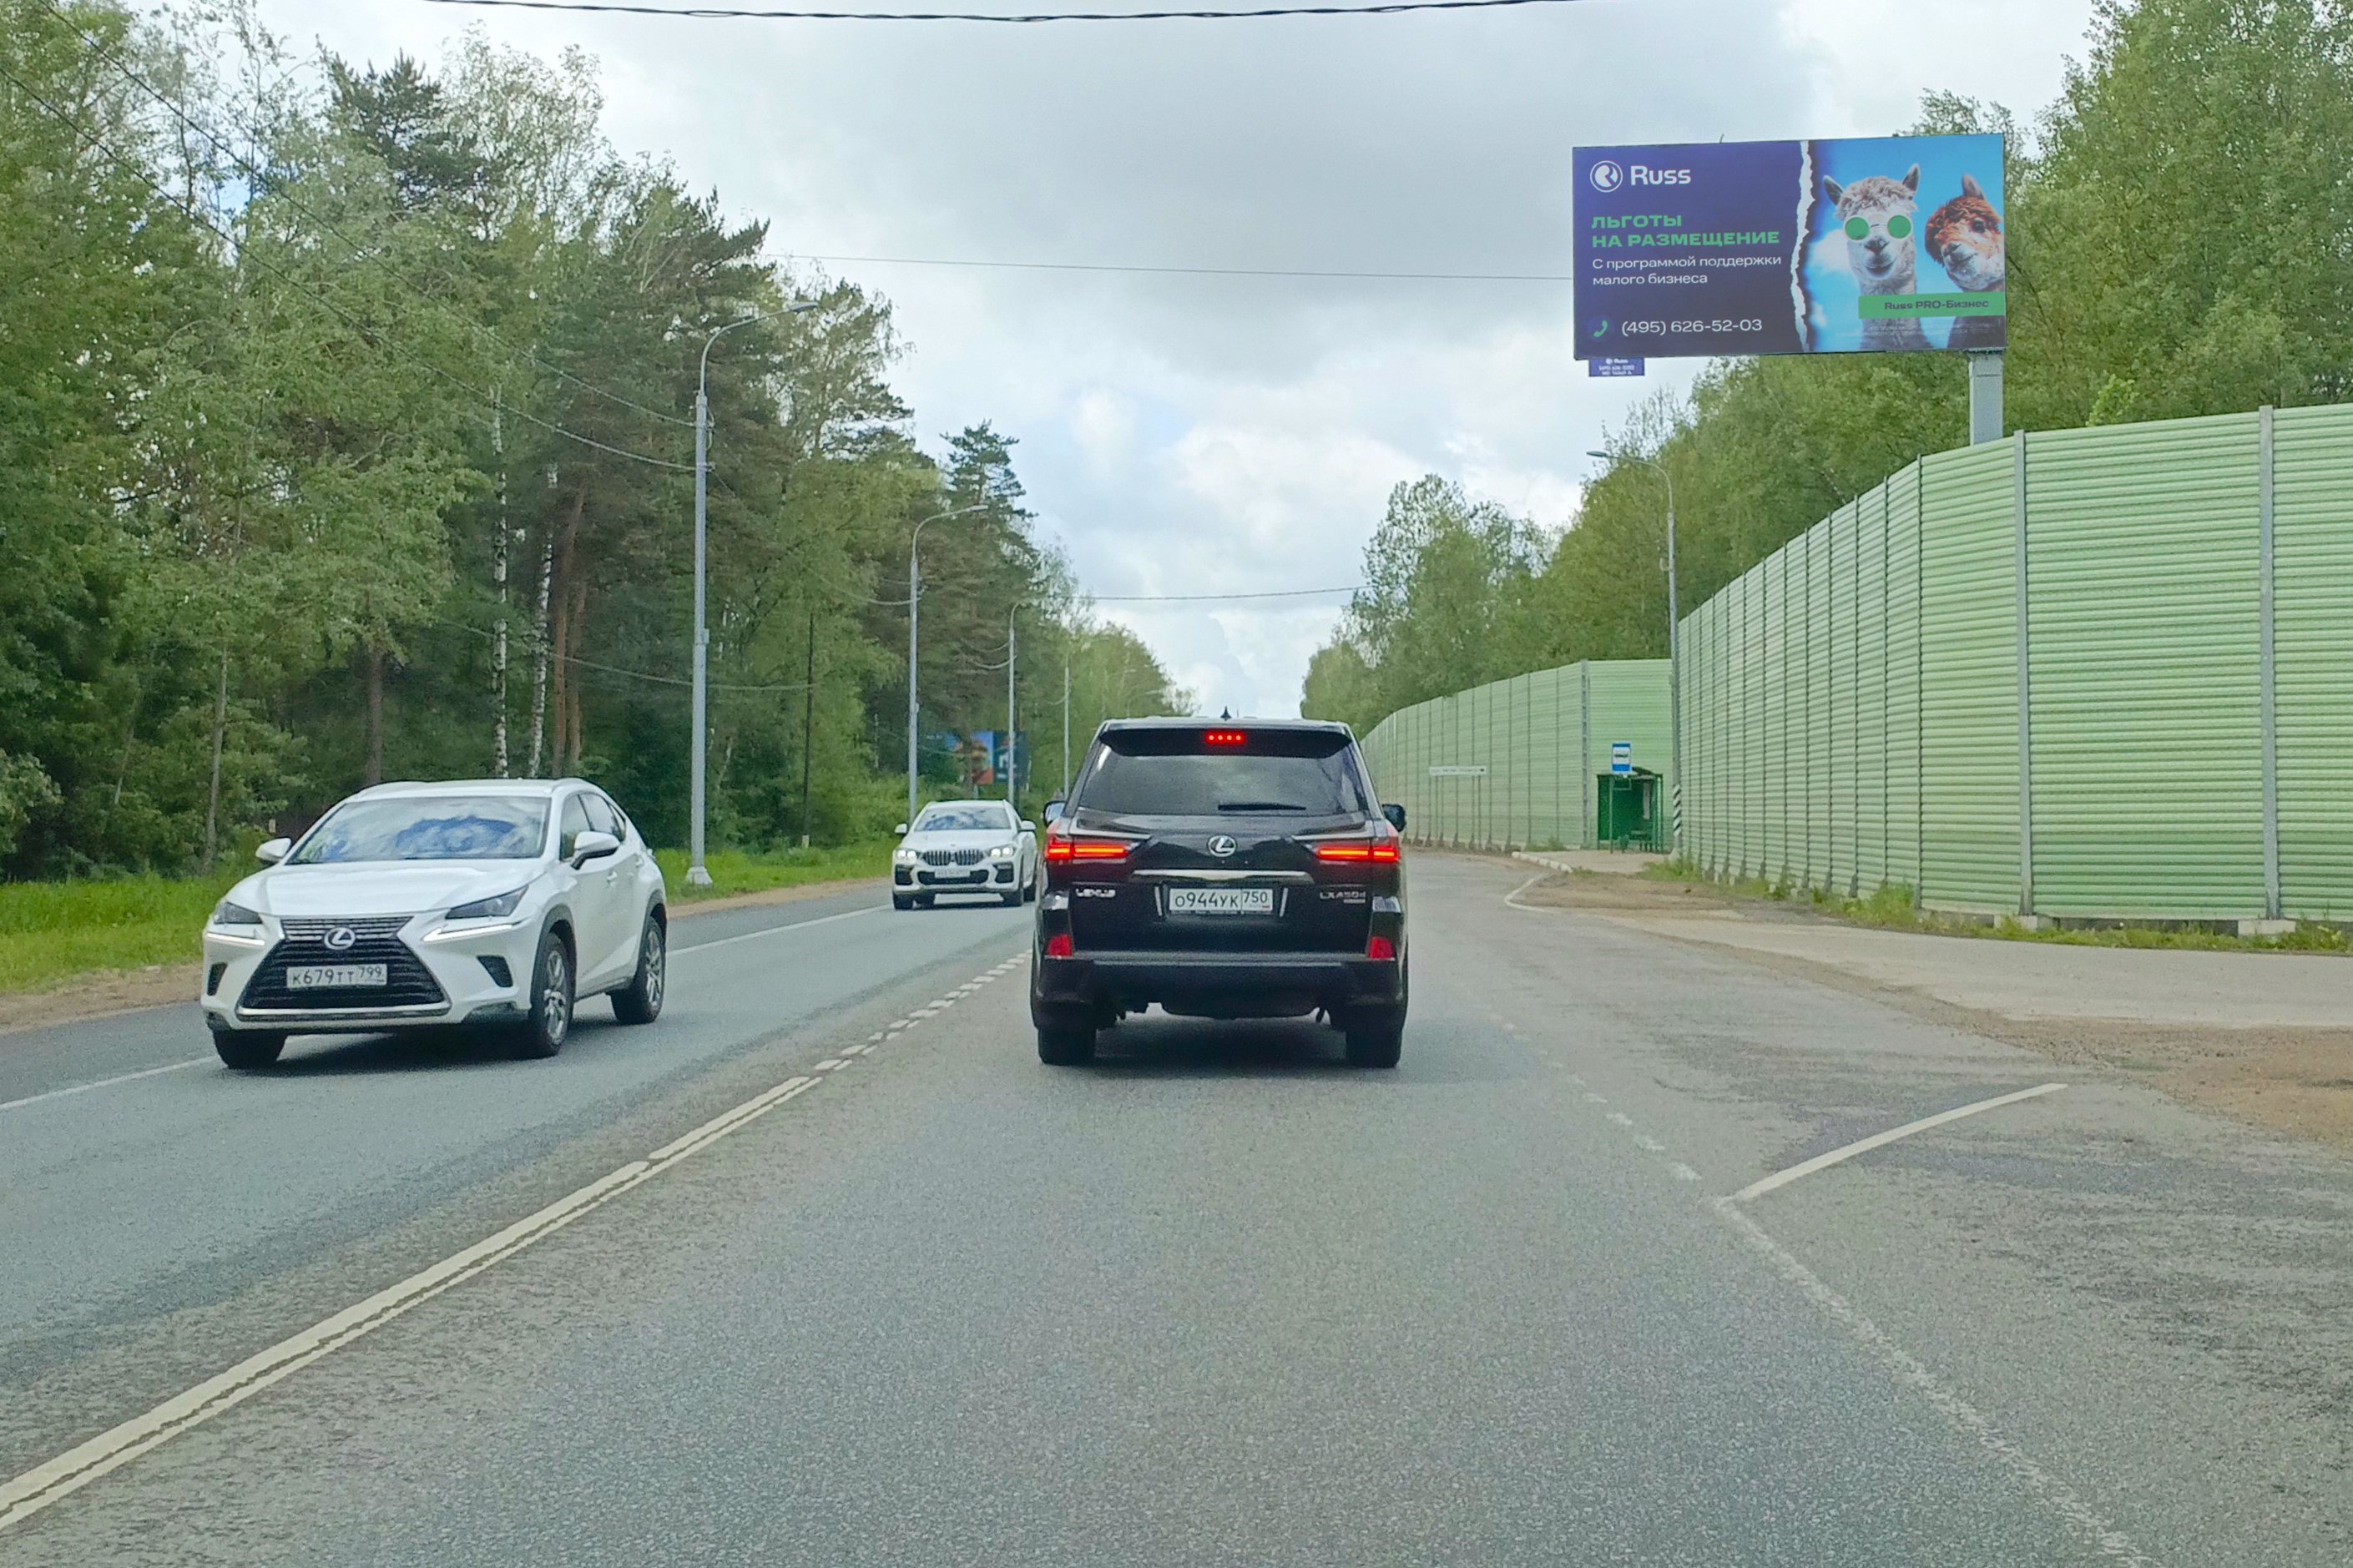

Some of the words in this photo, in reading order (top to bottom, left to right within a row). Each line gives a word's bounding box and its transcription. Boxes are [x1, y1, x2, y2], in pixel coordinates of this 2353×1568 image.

[1630, 165, 1691, 186] Russ
[1592, 214, 1682, 229] ЛЬГОТЫ
[1592, 235, 1623, 248] НА
[1628, 231, 1780, 247] РАЗМЕЩЕНИЕ
[1592, 259, 1603, 270] С
[1607, 255, 1696, 271] программой
[1699, 256, 1781, 269] поддержки
[1593, 275, 1645, 285] малого
[1648, 273, 1708, 285] бизнеса
[1884, 301, 1913, 310] Russ
[1916, 300, 1990, 309] PRO-Бизнес
[1622, 321, 1667, 336] (495)
[1670, 319, 1763, 333] 626-52-03
